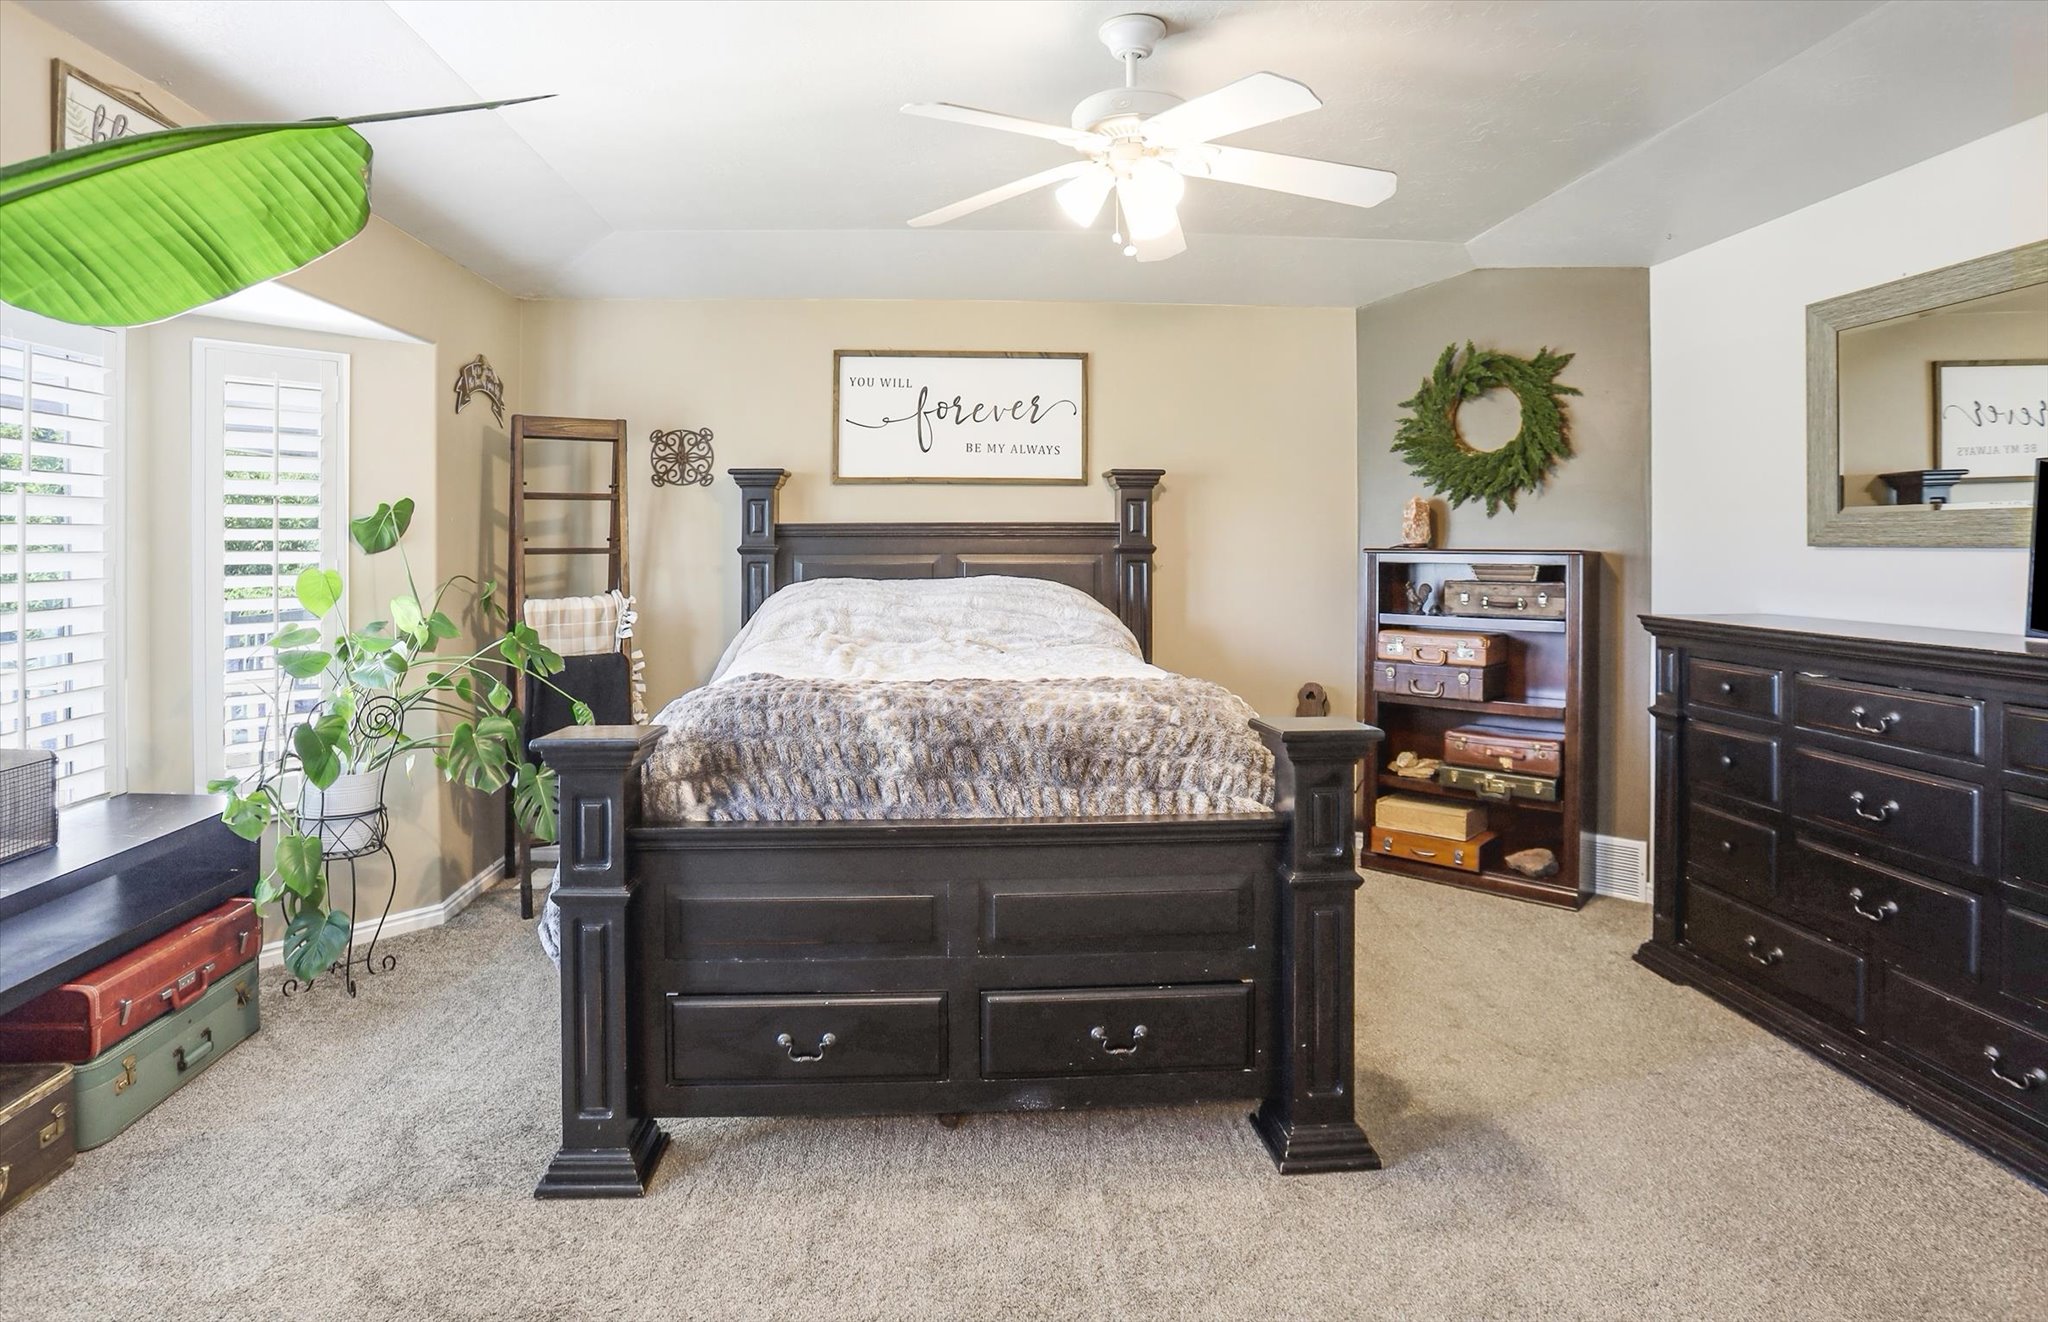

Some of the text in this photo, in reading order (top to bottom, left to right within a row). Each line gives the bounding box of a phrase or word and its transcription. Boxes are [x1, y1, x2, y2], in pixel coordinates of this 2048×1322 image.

[849, 376, 913, 389] YOU WILL
[846, 386, 1077, 453] forever
[965, 442, 1061, 455] BE MY ALWAYS
